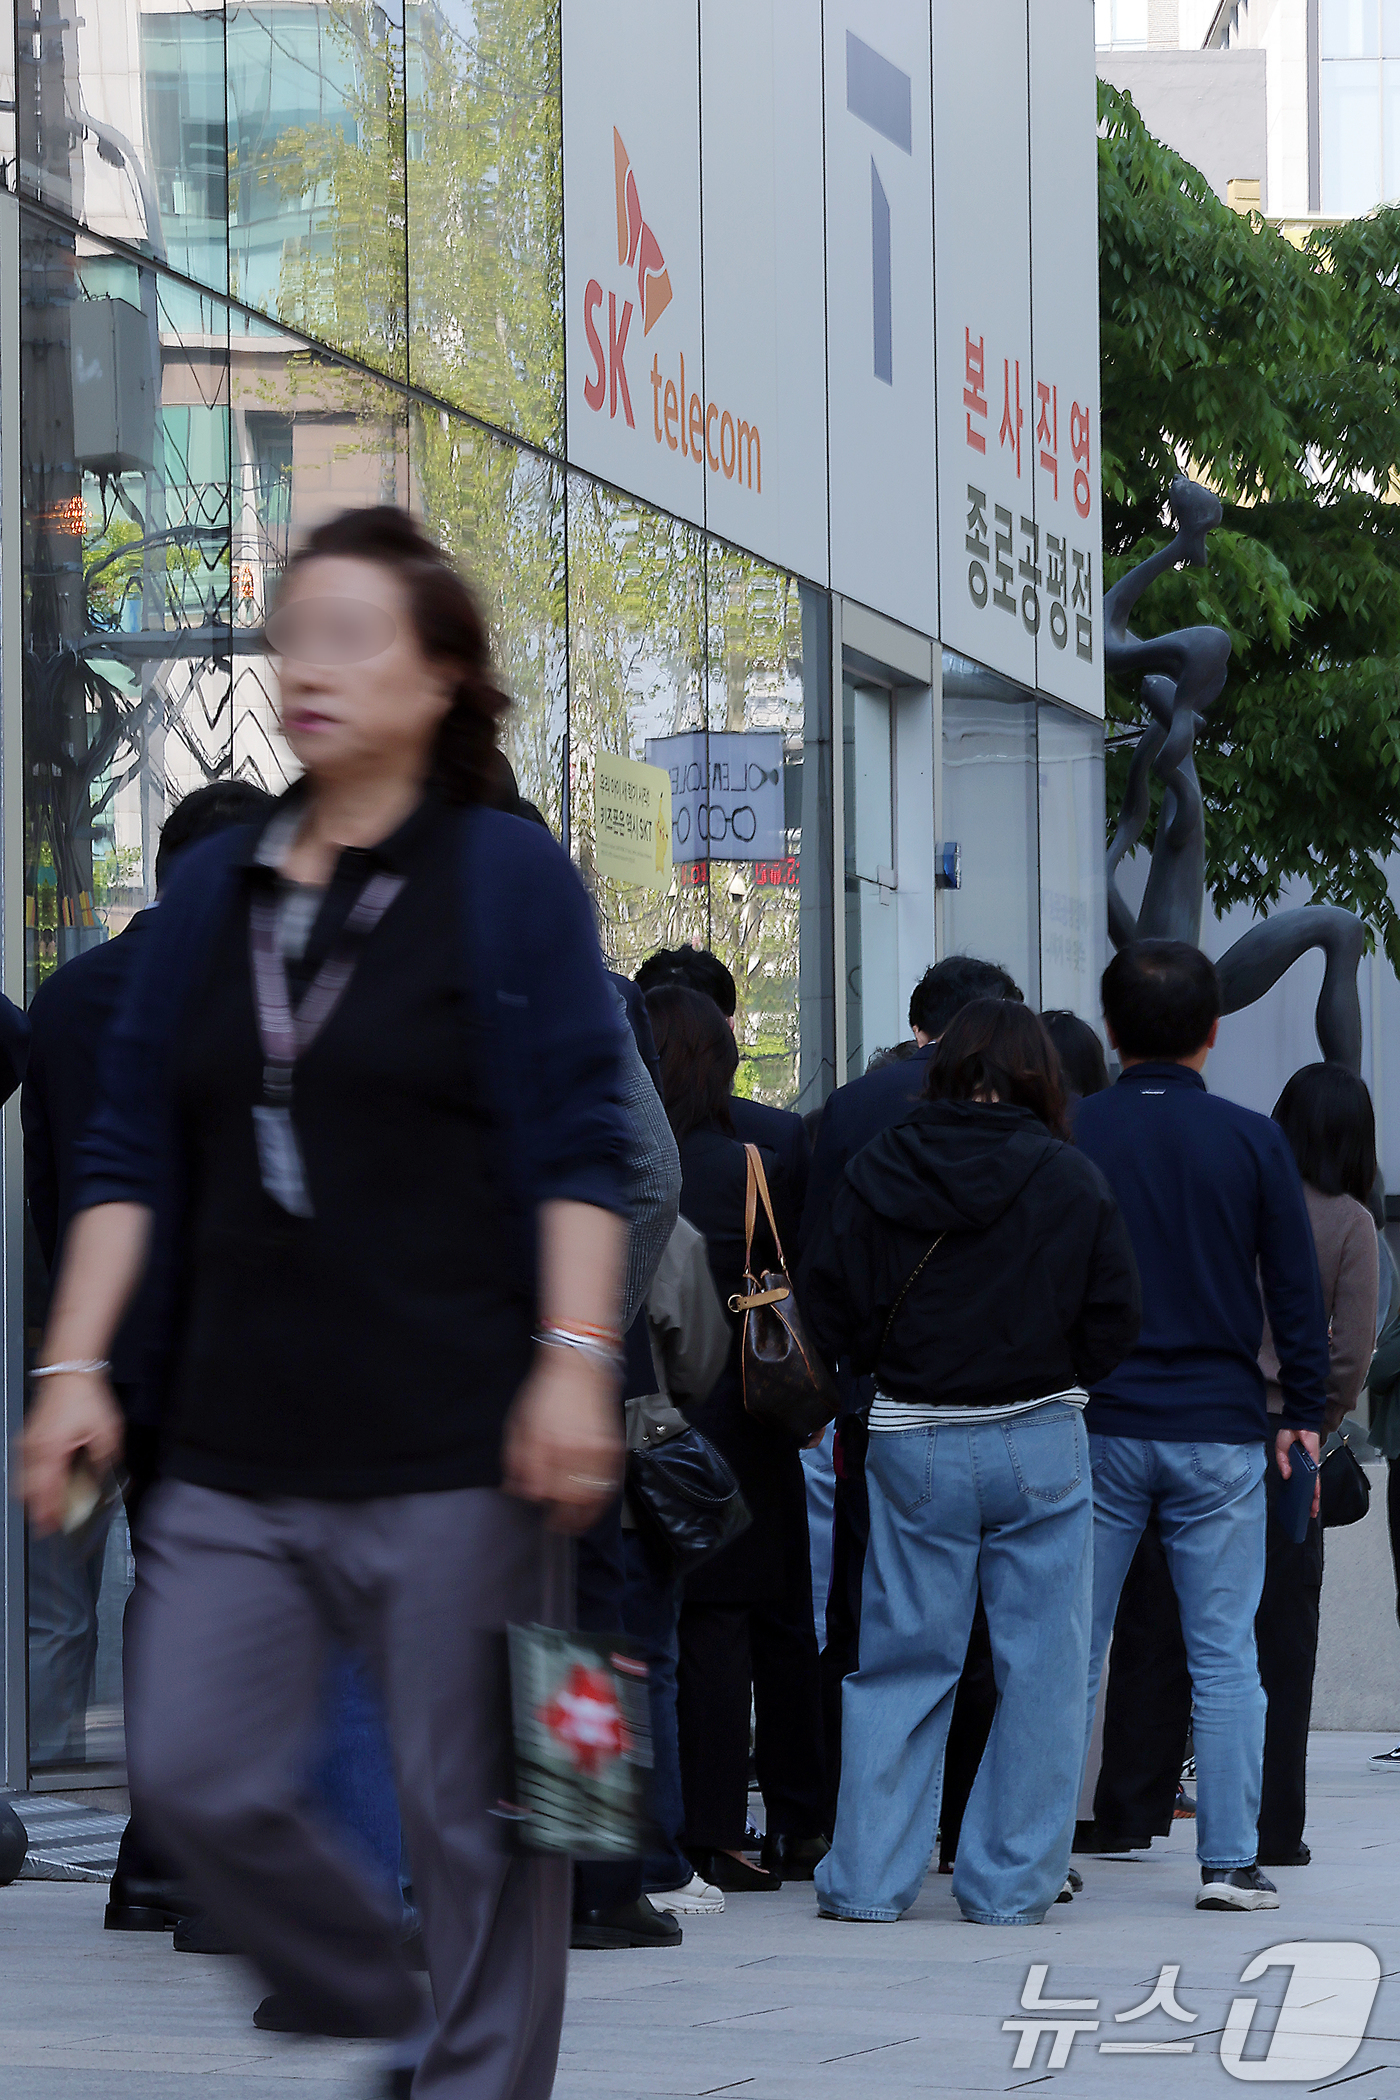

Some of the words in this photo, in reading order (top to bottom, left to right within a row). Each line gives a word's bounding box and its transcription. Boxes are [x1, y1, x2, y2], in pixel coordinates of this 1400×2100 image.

[584, 278, 635, 429] SK
[650, 351, 761, 494] telecom
[963, 326, 1090, 519] 본사직영
[965, 484, 1093, 664] 종로공평점
[640, 818, 652, 841] SKT
